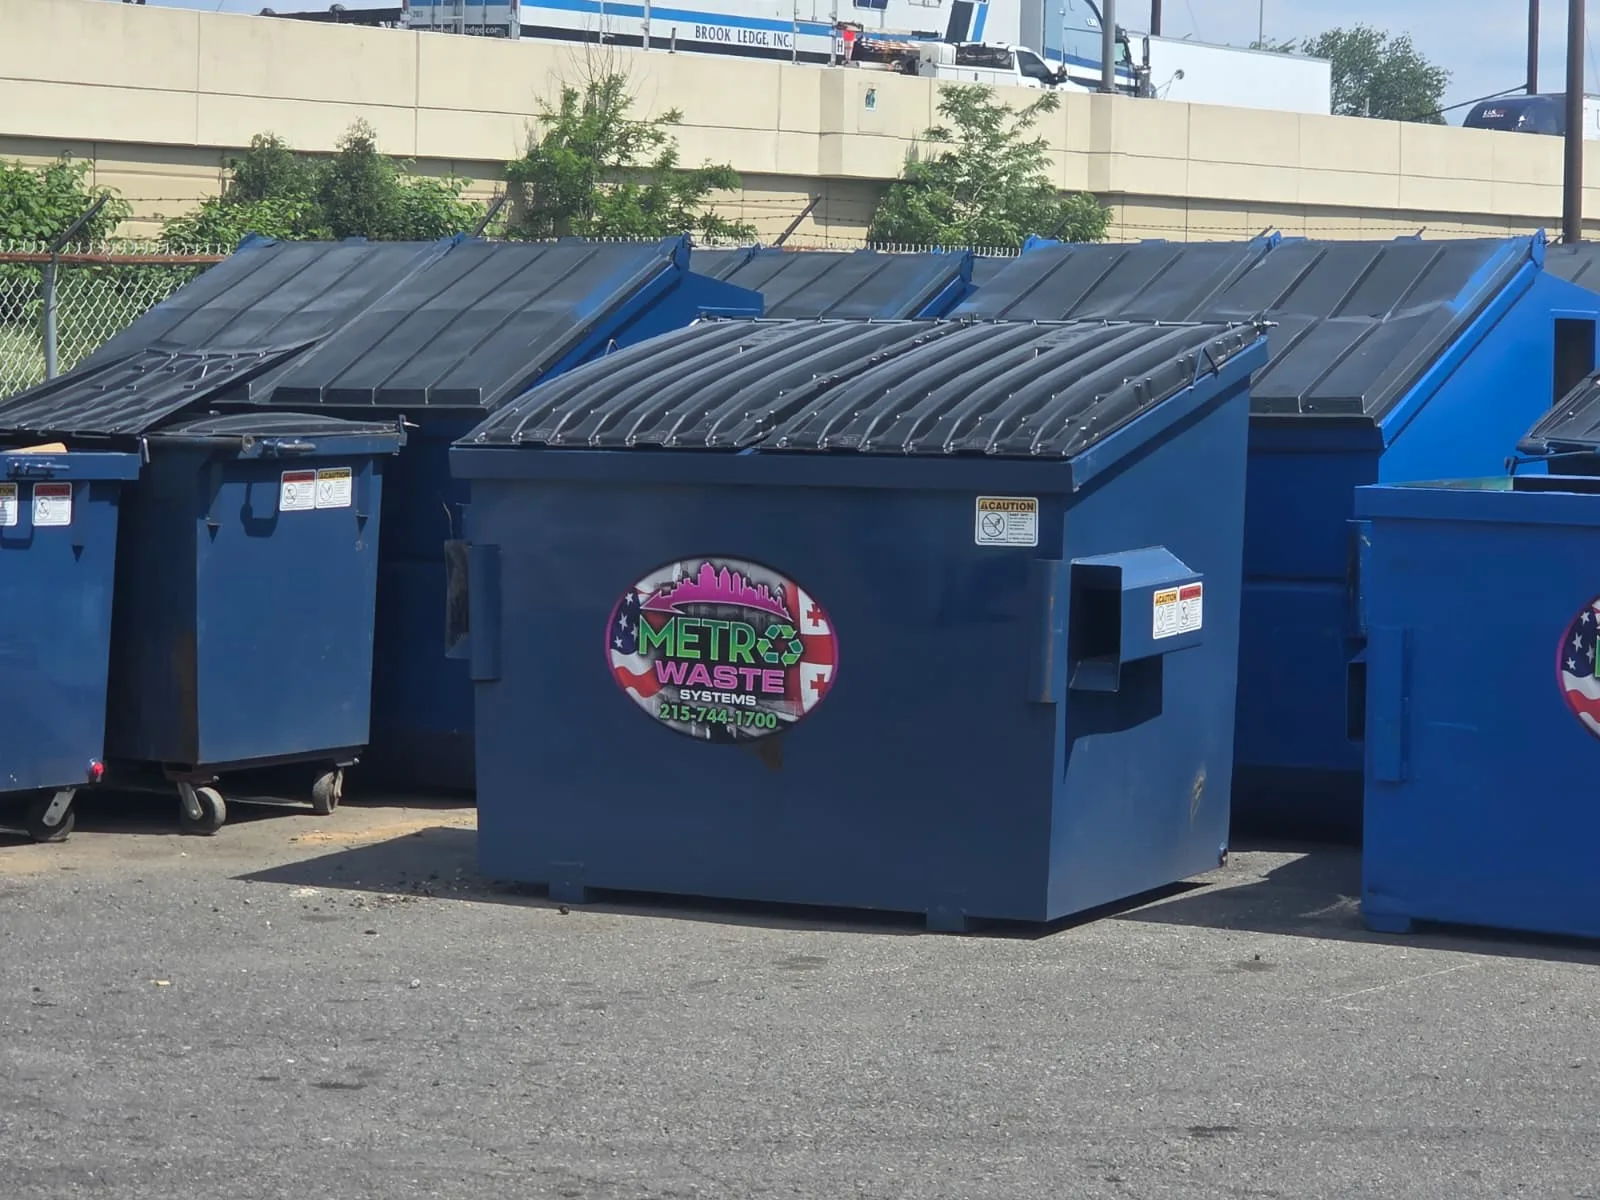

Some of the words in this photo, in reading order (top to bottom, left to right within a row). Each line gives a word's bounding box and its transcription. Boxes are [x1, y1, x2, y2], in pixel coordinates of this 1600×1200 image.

[695, 25, 731, 42] BROOK
[773, 32, 793, 48] INC.
[988, 502, 1034, 511] CAUTION
[655, 660, 785, 694] WASTE
[680, 689, 757, 706] SYSTEMS
[659, 703, 777, 729] 215-744-1700
